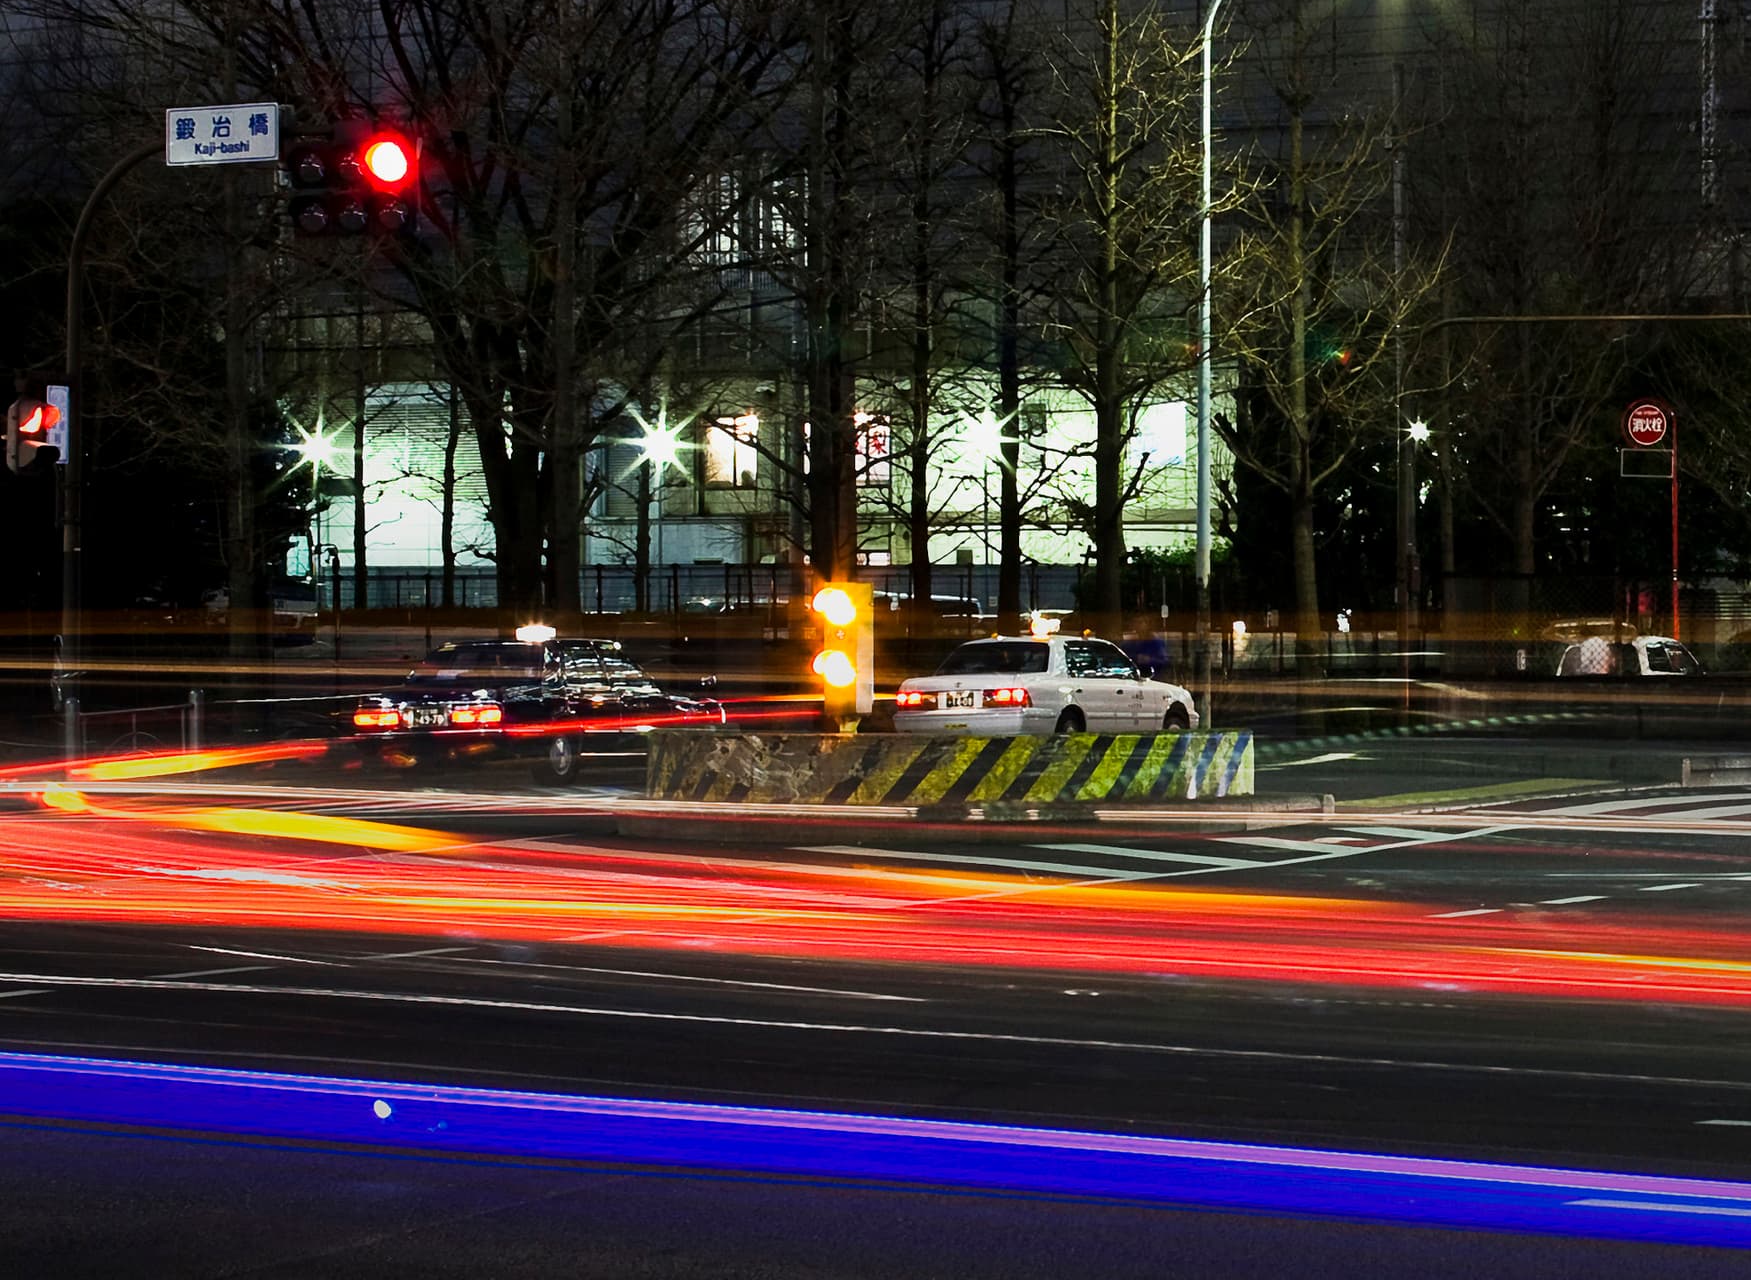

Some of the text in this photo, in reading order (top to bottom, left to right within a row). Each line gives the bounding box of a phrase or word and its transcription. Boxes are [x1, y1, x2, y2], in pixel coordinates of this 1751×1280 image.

[195, 141, 249, 156] Kaji-bashi
[1632, 417, 1663, 433] 消火栓
